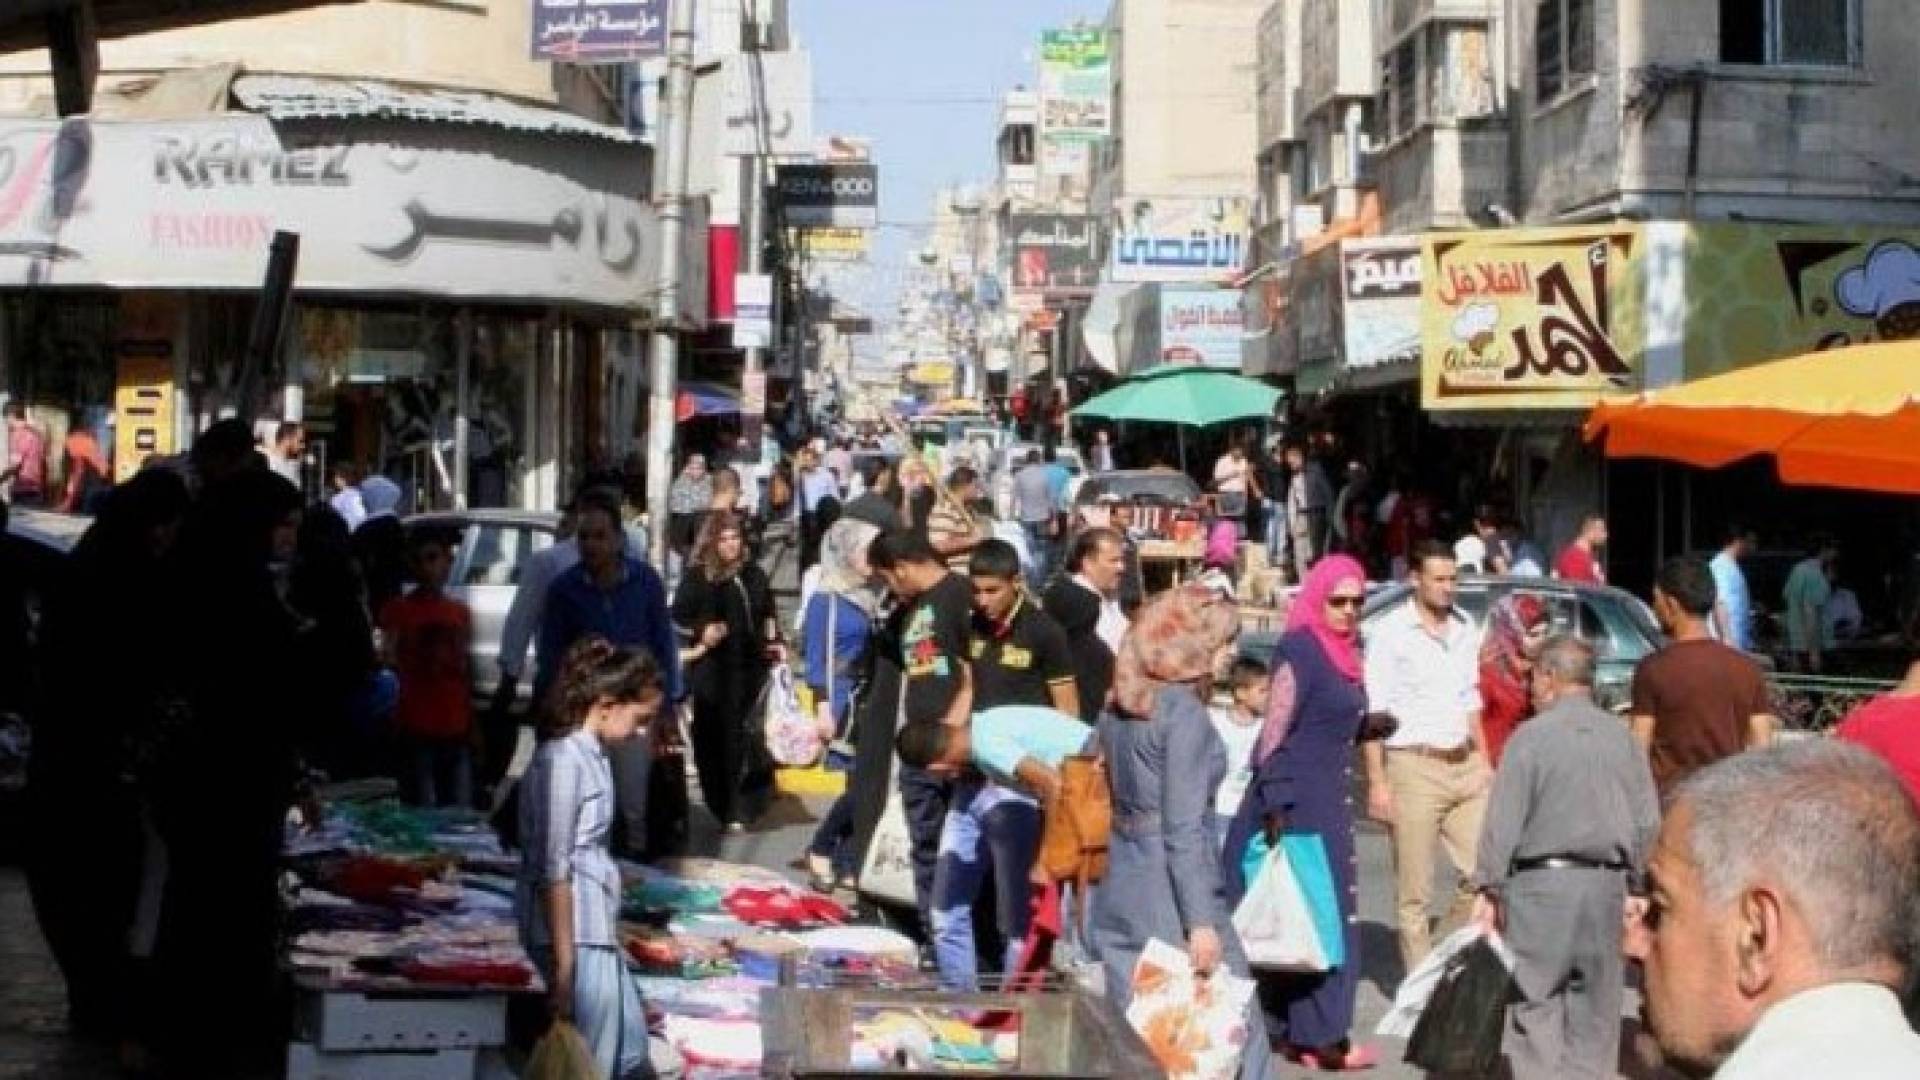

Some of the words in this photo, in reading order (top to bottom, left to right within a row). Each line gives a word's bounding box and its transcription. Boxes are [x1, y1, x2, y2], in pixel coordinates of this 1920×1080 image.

[597, 7, 659, 37] مؤسسة
[152, 136, 352, 188] RAMEZ
[1435, 260, 1532, 306] الفلافل
